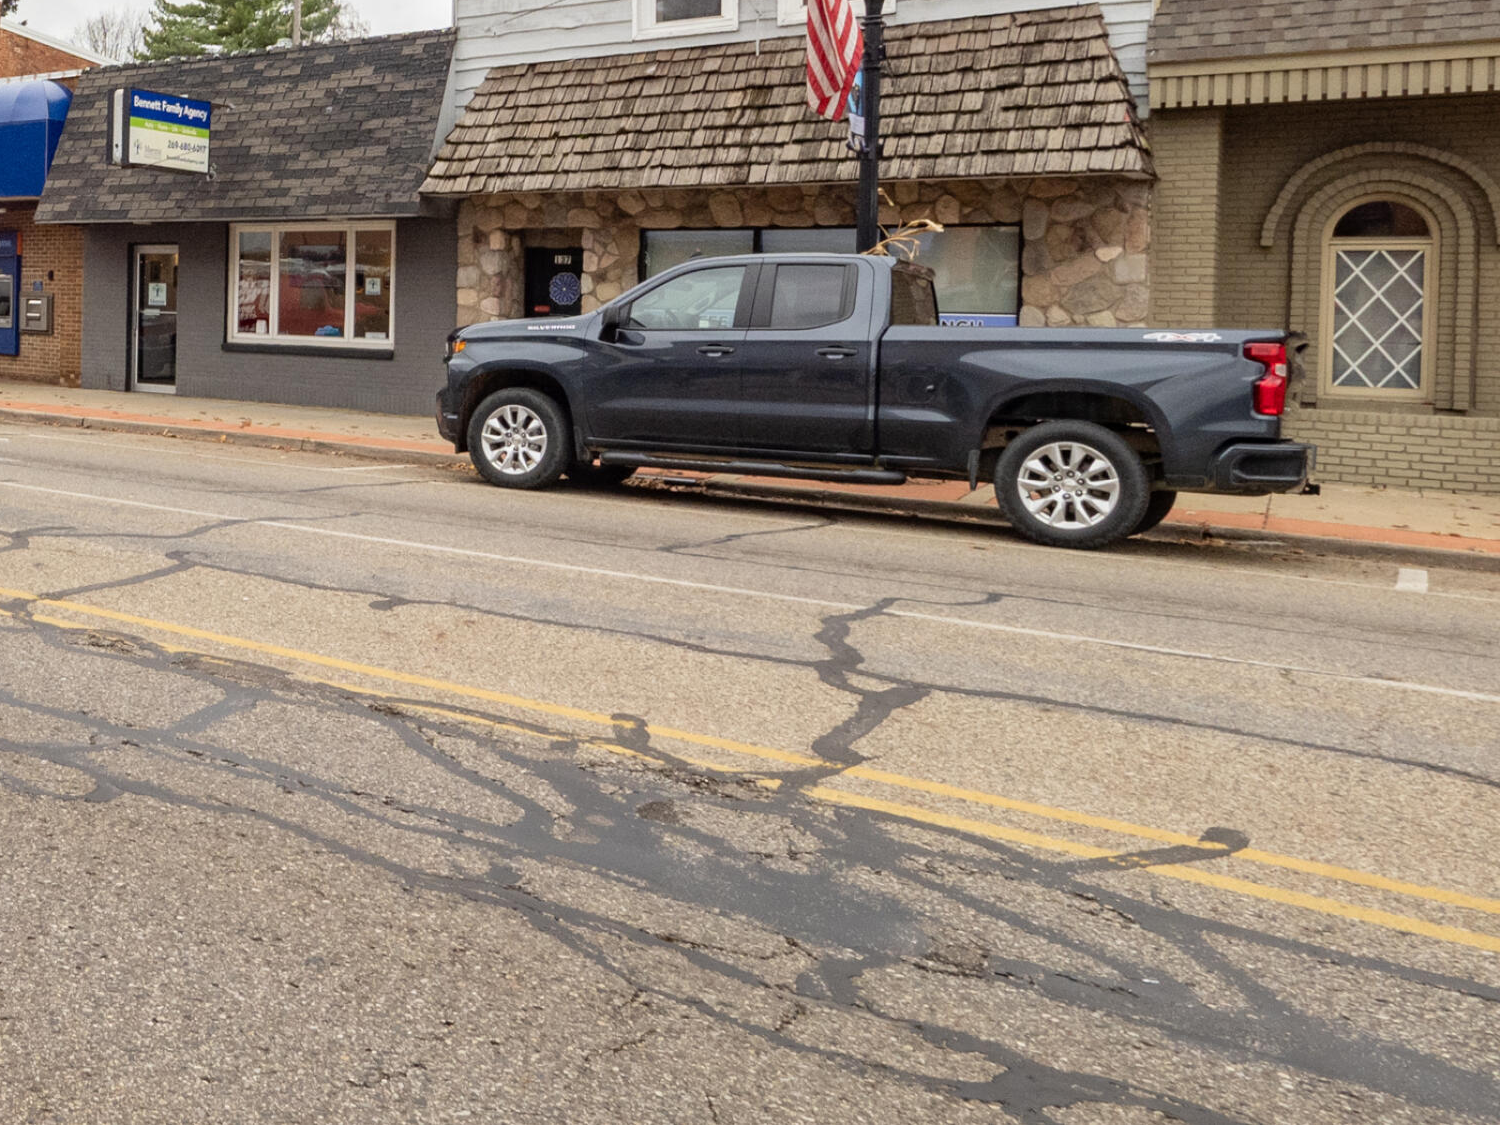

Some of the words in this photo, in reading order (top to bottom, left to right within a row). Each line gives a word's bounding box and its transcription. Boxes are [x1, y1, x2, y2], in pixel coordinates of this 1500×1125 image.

[133, 95, 161, 111] Bennett
[162, 100, 183, 118] Family
[183, 105, 208, 122] Agency
